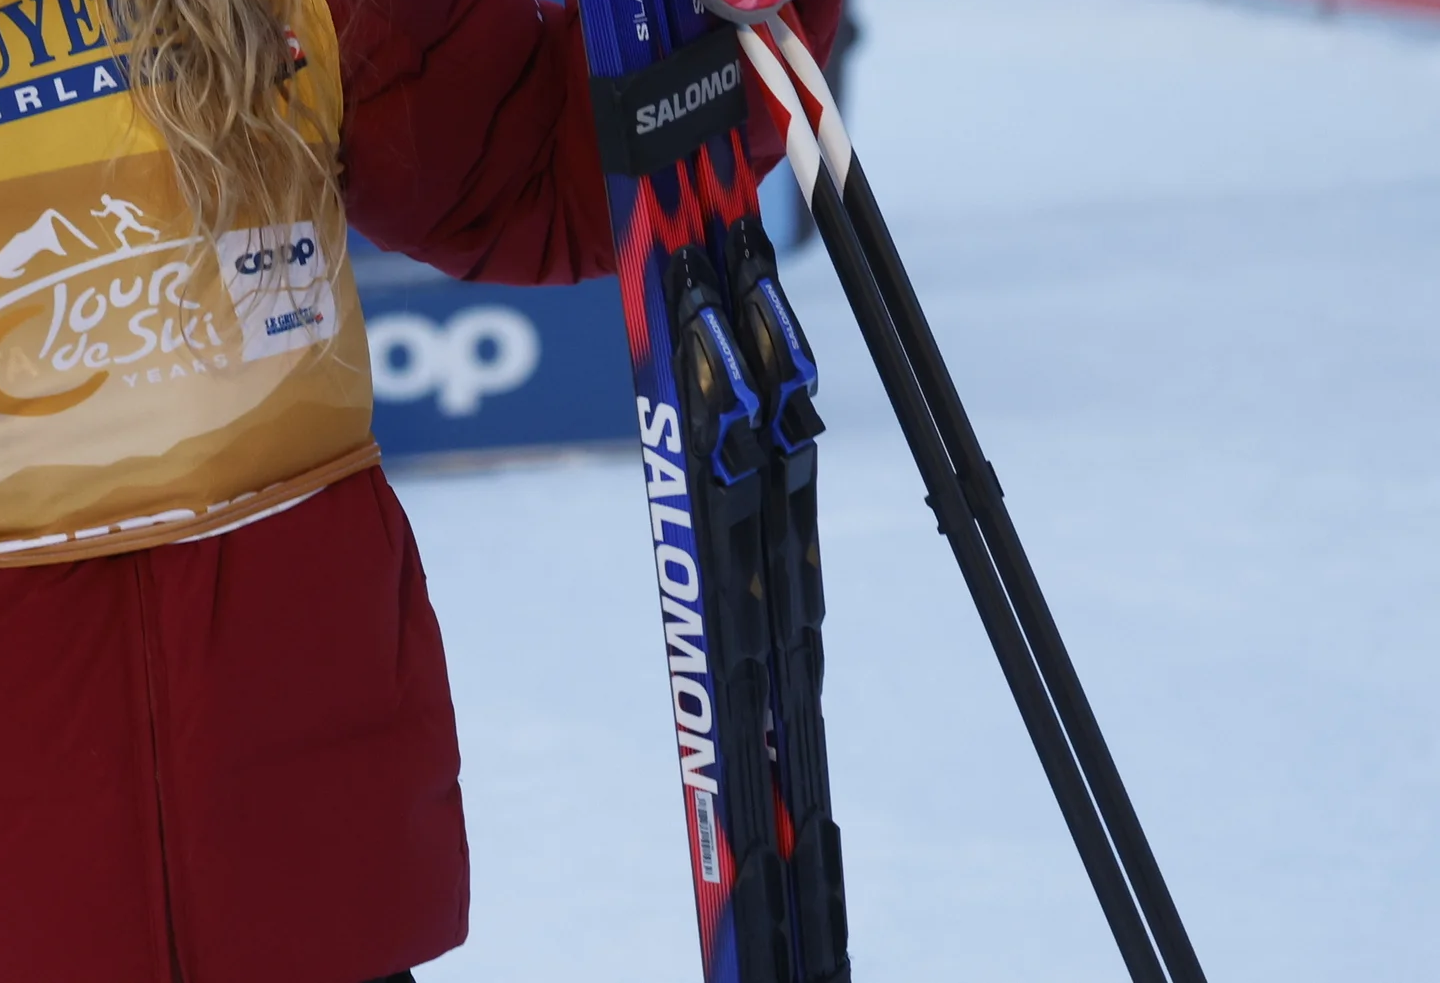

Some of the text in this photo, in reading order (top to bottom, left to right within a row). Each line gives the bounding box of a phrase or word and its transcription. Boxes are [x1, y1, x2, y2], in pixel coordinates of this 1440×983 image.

[636, 59, 741, 135] SALOMO
[707, 313, 741, 380] SALOMON
[766, 283, 799, 351] SALOMON
[51, 332, 111, 371] de
[121, 354, 229, 388] YEARS
[364, 304, 540, 417] op
[636, 394, 718, 796] SALOMON
